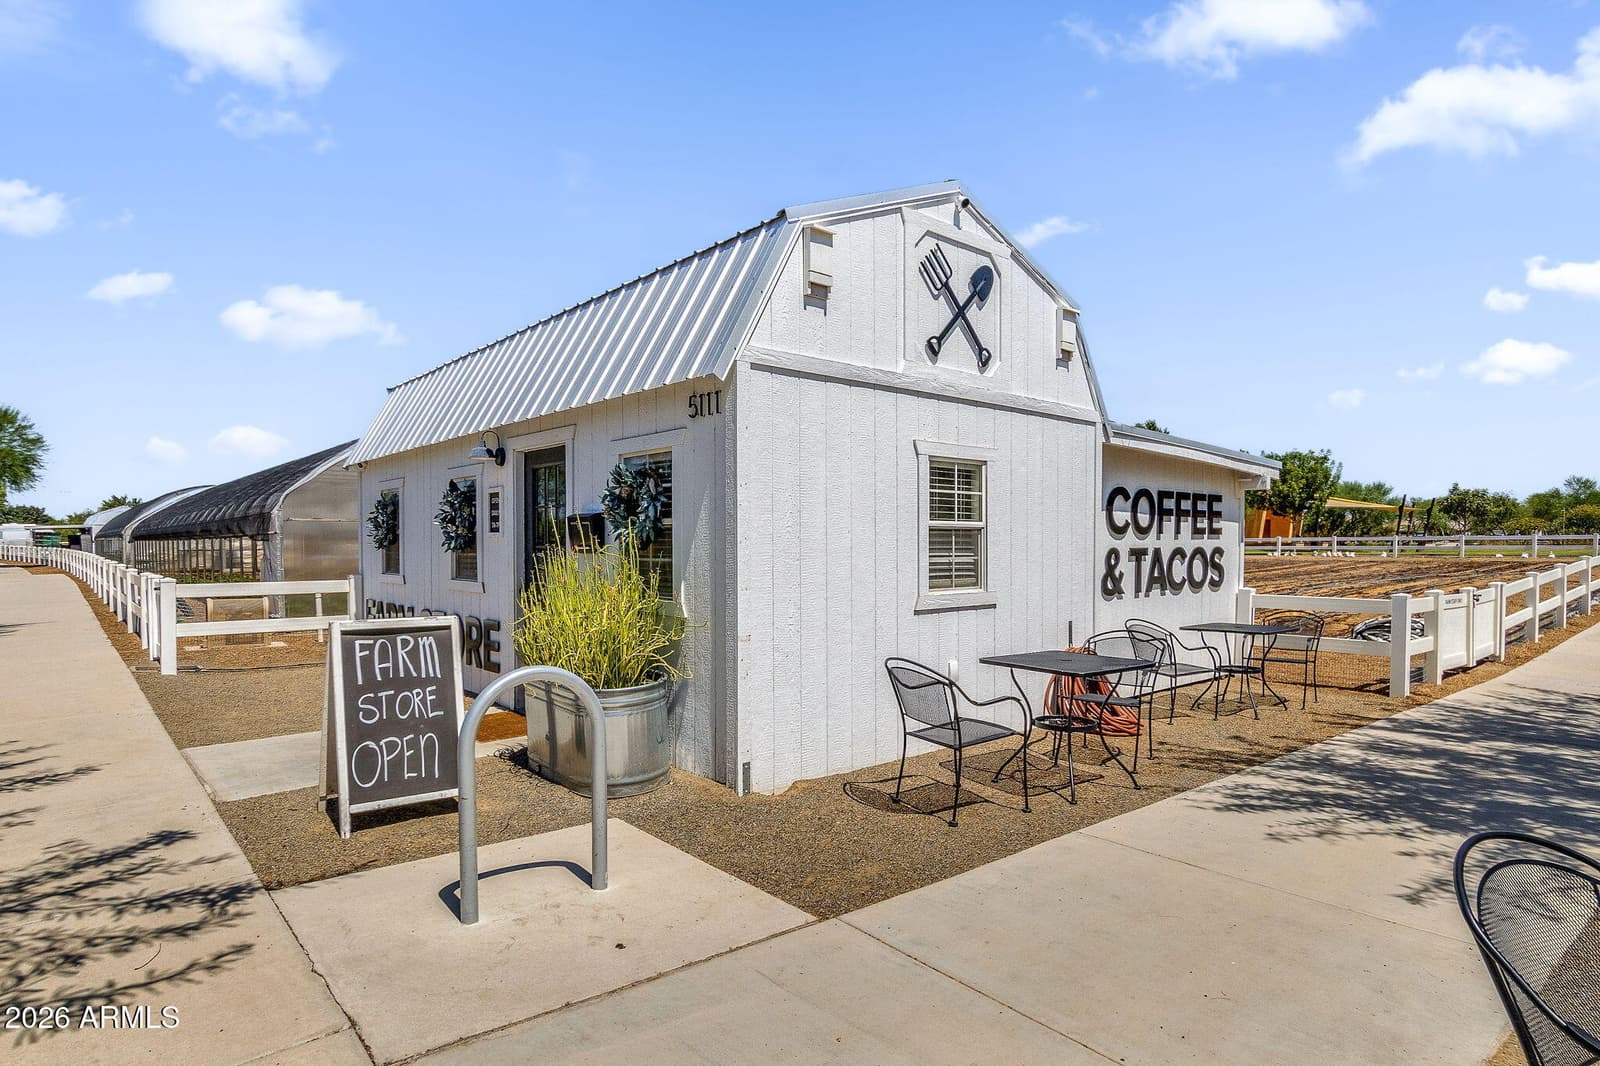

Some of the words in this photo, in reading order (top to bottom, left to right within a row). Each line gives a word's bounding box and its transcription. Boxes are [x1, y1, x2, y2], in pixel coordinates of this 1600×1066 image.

[689, 390, 721, 418] 5111
[1106, 486, 1223, 538] COFFEE
[1101, 548, 1125, 600] &
[1128, 546, 1225, 598] TACOS
[355, 635, 442, 685] FARM
[358, 685, 444, 724] STORE
